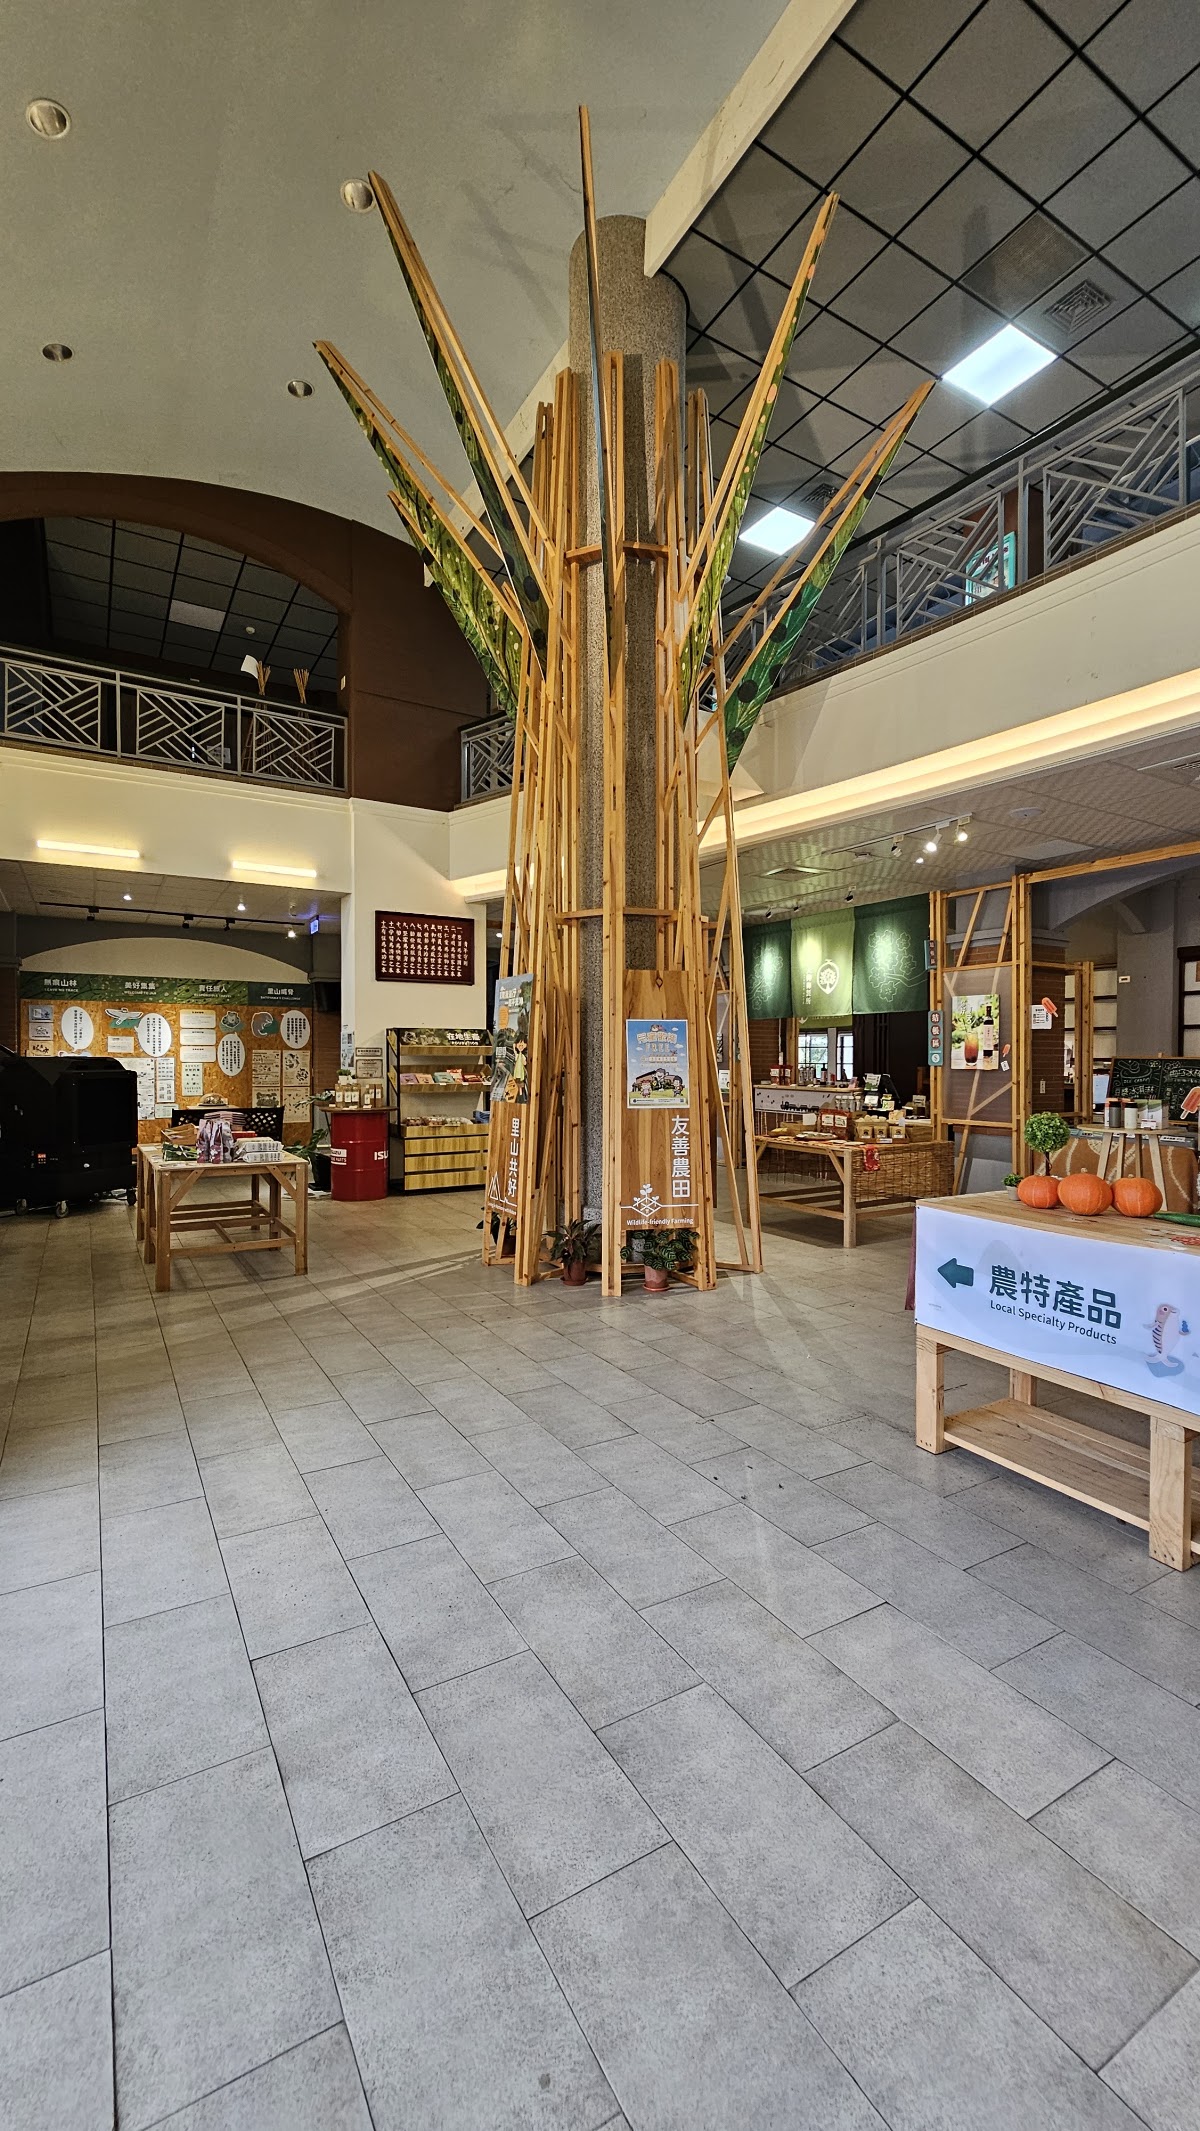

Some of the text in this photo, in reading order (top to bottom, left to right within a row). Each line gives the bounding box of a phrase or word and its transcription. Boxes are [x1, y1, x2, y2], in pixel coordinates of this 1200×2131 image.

[508, 1118, 520, 1198] 里山共好
[671, 1115, 690, 1198] 友善農田
[989, 1265, 1121, 1329] 農特產品
[990, 1300, 1117, 1345] Local Specialty Products
